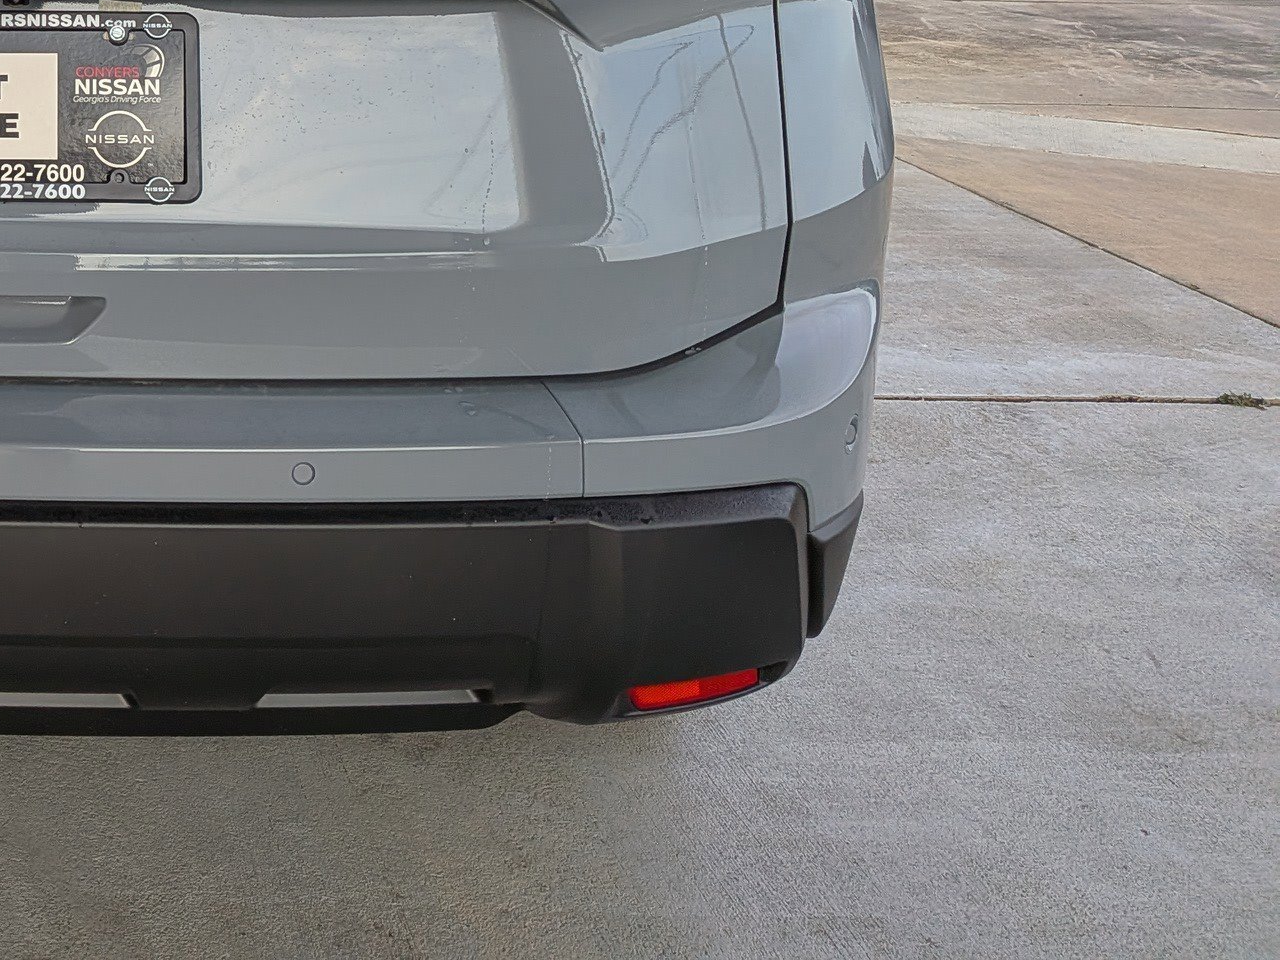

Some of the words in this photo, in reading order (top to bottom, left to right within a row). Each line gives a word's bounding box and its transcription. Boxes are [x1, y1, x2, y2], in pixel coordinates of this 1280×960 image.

[75, 66, 140, 78] CONYERS
[74, 78, 160, 95] NISSAN
[73, 95, 110, 105] Georgia's
[110, 95, 138, 105] Driving
[138, 95, 162, 103] Force
[85, 134, 155, 144] NISSAN
